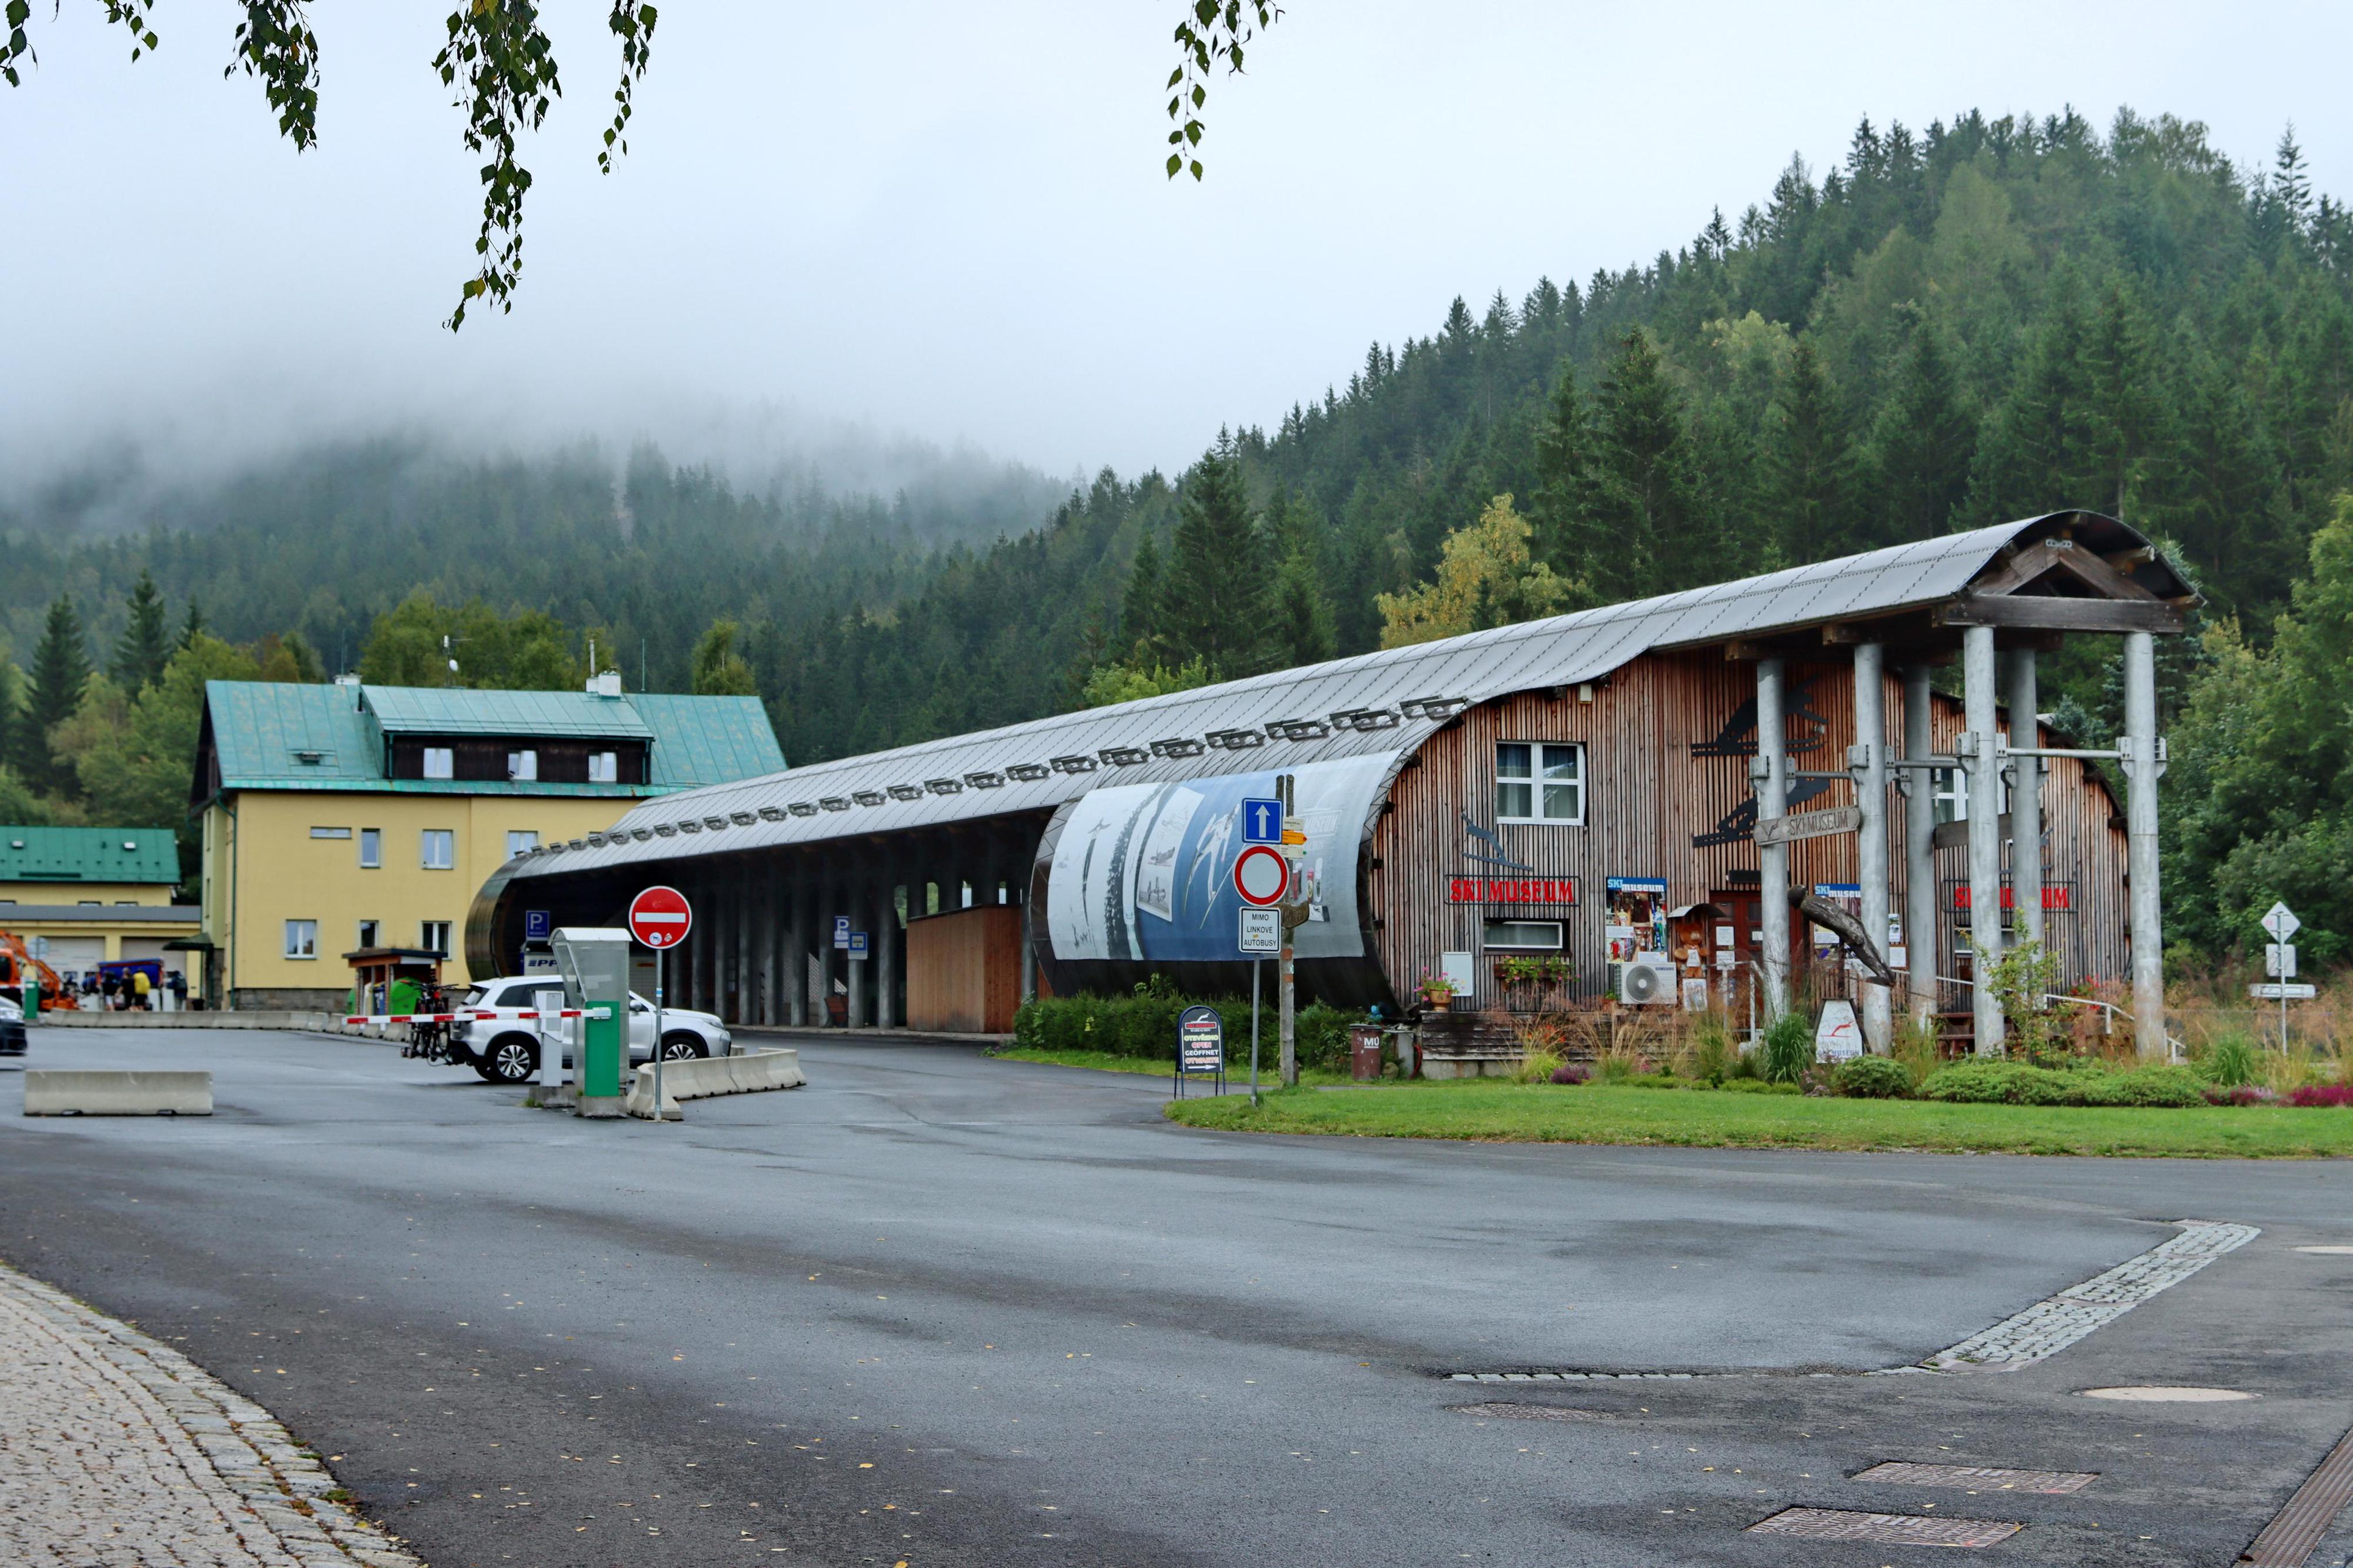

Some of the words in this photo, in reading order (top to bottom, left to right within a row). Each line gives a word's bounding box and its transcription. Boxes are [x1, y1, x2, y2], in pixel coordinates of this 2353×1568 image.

[1789, 818, 1805, 835] SKI
[1808, 811, 1848, 833] MUSEUM
[1608, 879, 1623, 888] SKI
[1622, 883, 1664, 892] museum
[1815, 885, 1830, 895] SKI
[1450, 880, 1482, 901] SKI
[1488, 880, 1573, 902] MUSEUM
[531, 913, 542, 930] P
[837, 919, 849, 935] P
[1247, 925, 1273, 933] LINKOVÉ
